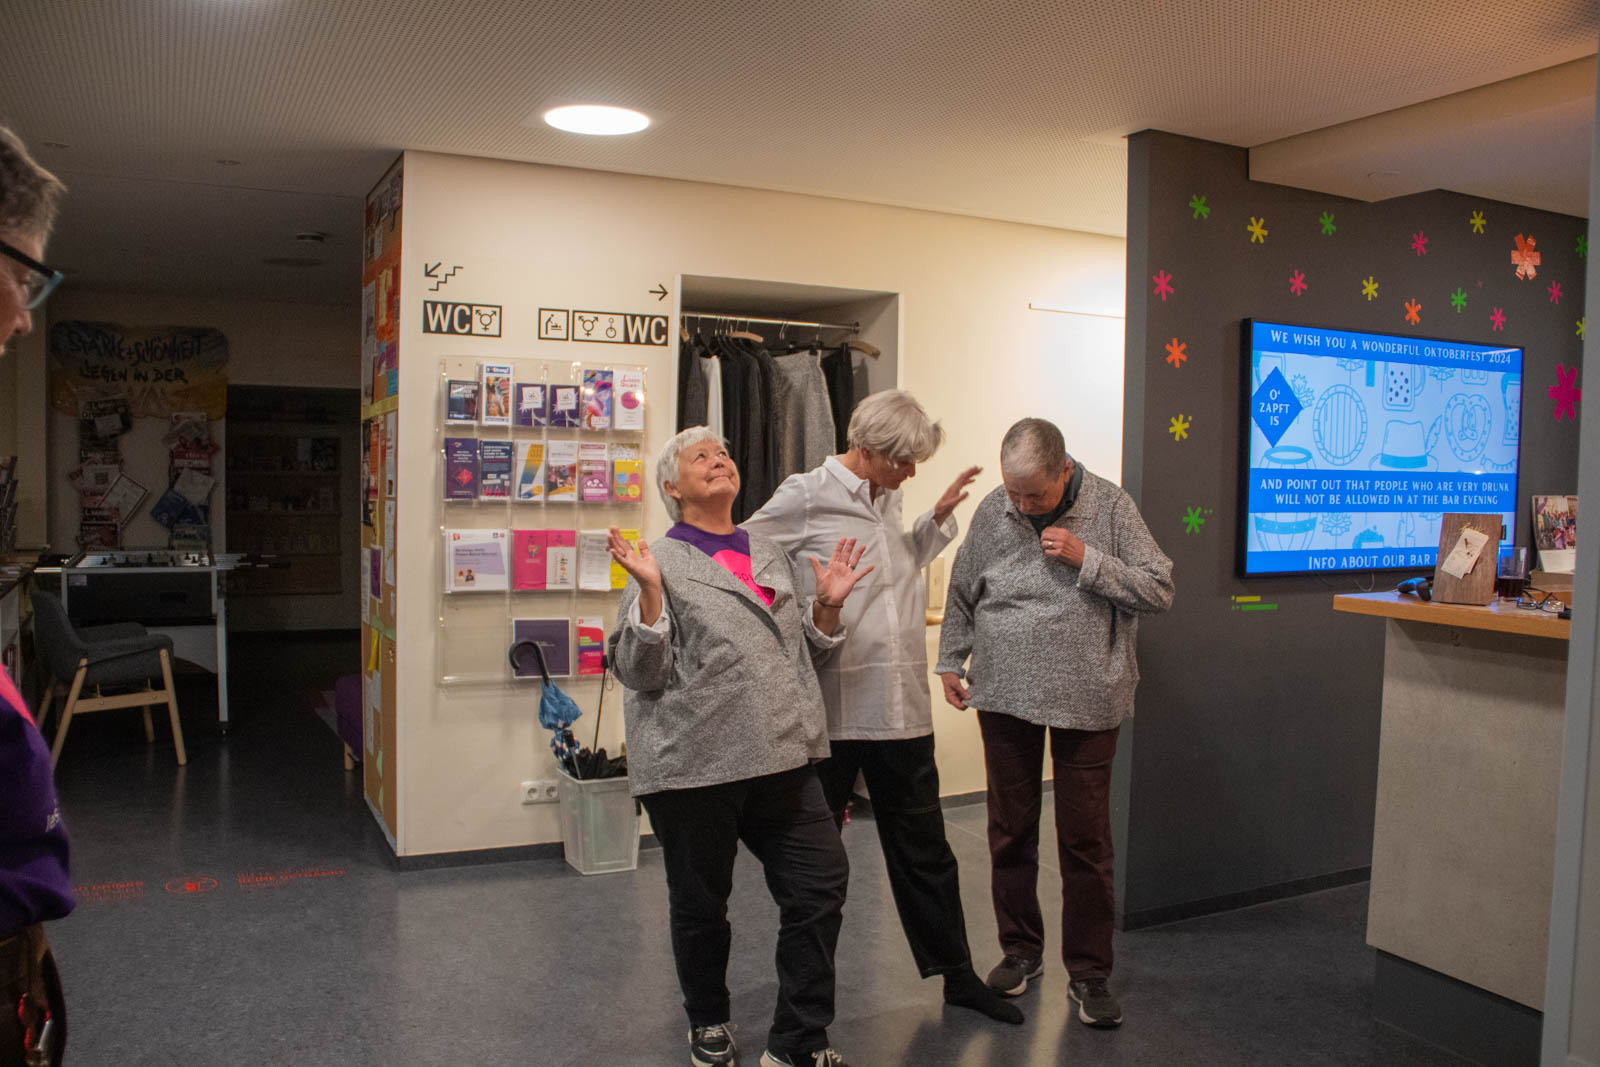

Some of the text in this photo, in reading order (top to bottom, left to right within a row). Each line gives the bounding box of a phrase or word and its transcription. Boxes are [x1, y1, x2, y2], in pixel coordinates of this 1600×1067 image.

[425, 302, 471, 334] WC
[625, 314, 667, 345] WC
[1271, 329, 1511, 364] WE WISH YOU A WONDERFUL OKTOBERFEST 2024
[152, 367, 188, 384] DER
[1259, 402, 1291, 414] ZAPFT
[1270, 415, 1280, 426] IS
[1260, 479, 1509, 492] AND POINT OUT THAT PEOPLE WHO ARE VERY DRUNK
[1275, 494, 1498, 504] WILL NOT BE ALLOWED IN AT THE BAR EVENING
[1308, 556, 1336, 569] INFO
[1340, 555, 1379, 568] ABOUT
[1382, 554, 1405, 567] OUR
[1410, 554, 1431, 565] BAR
